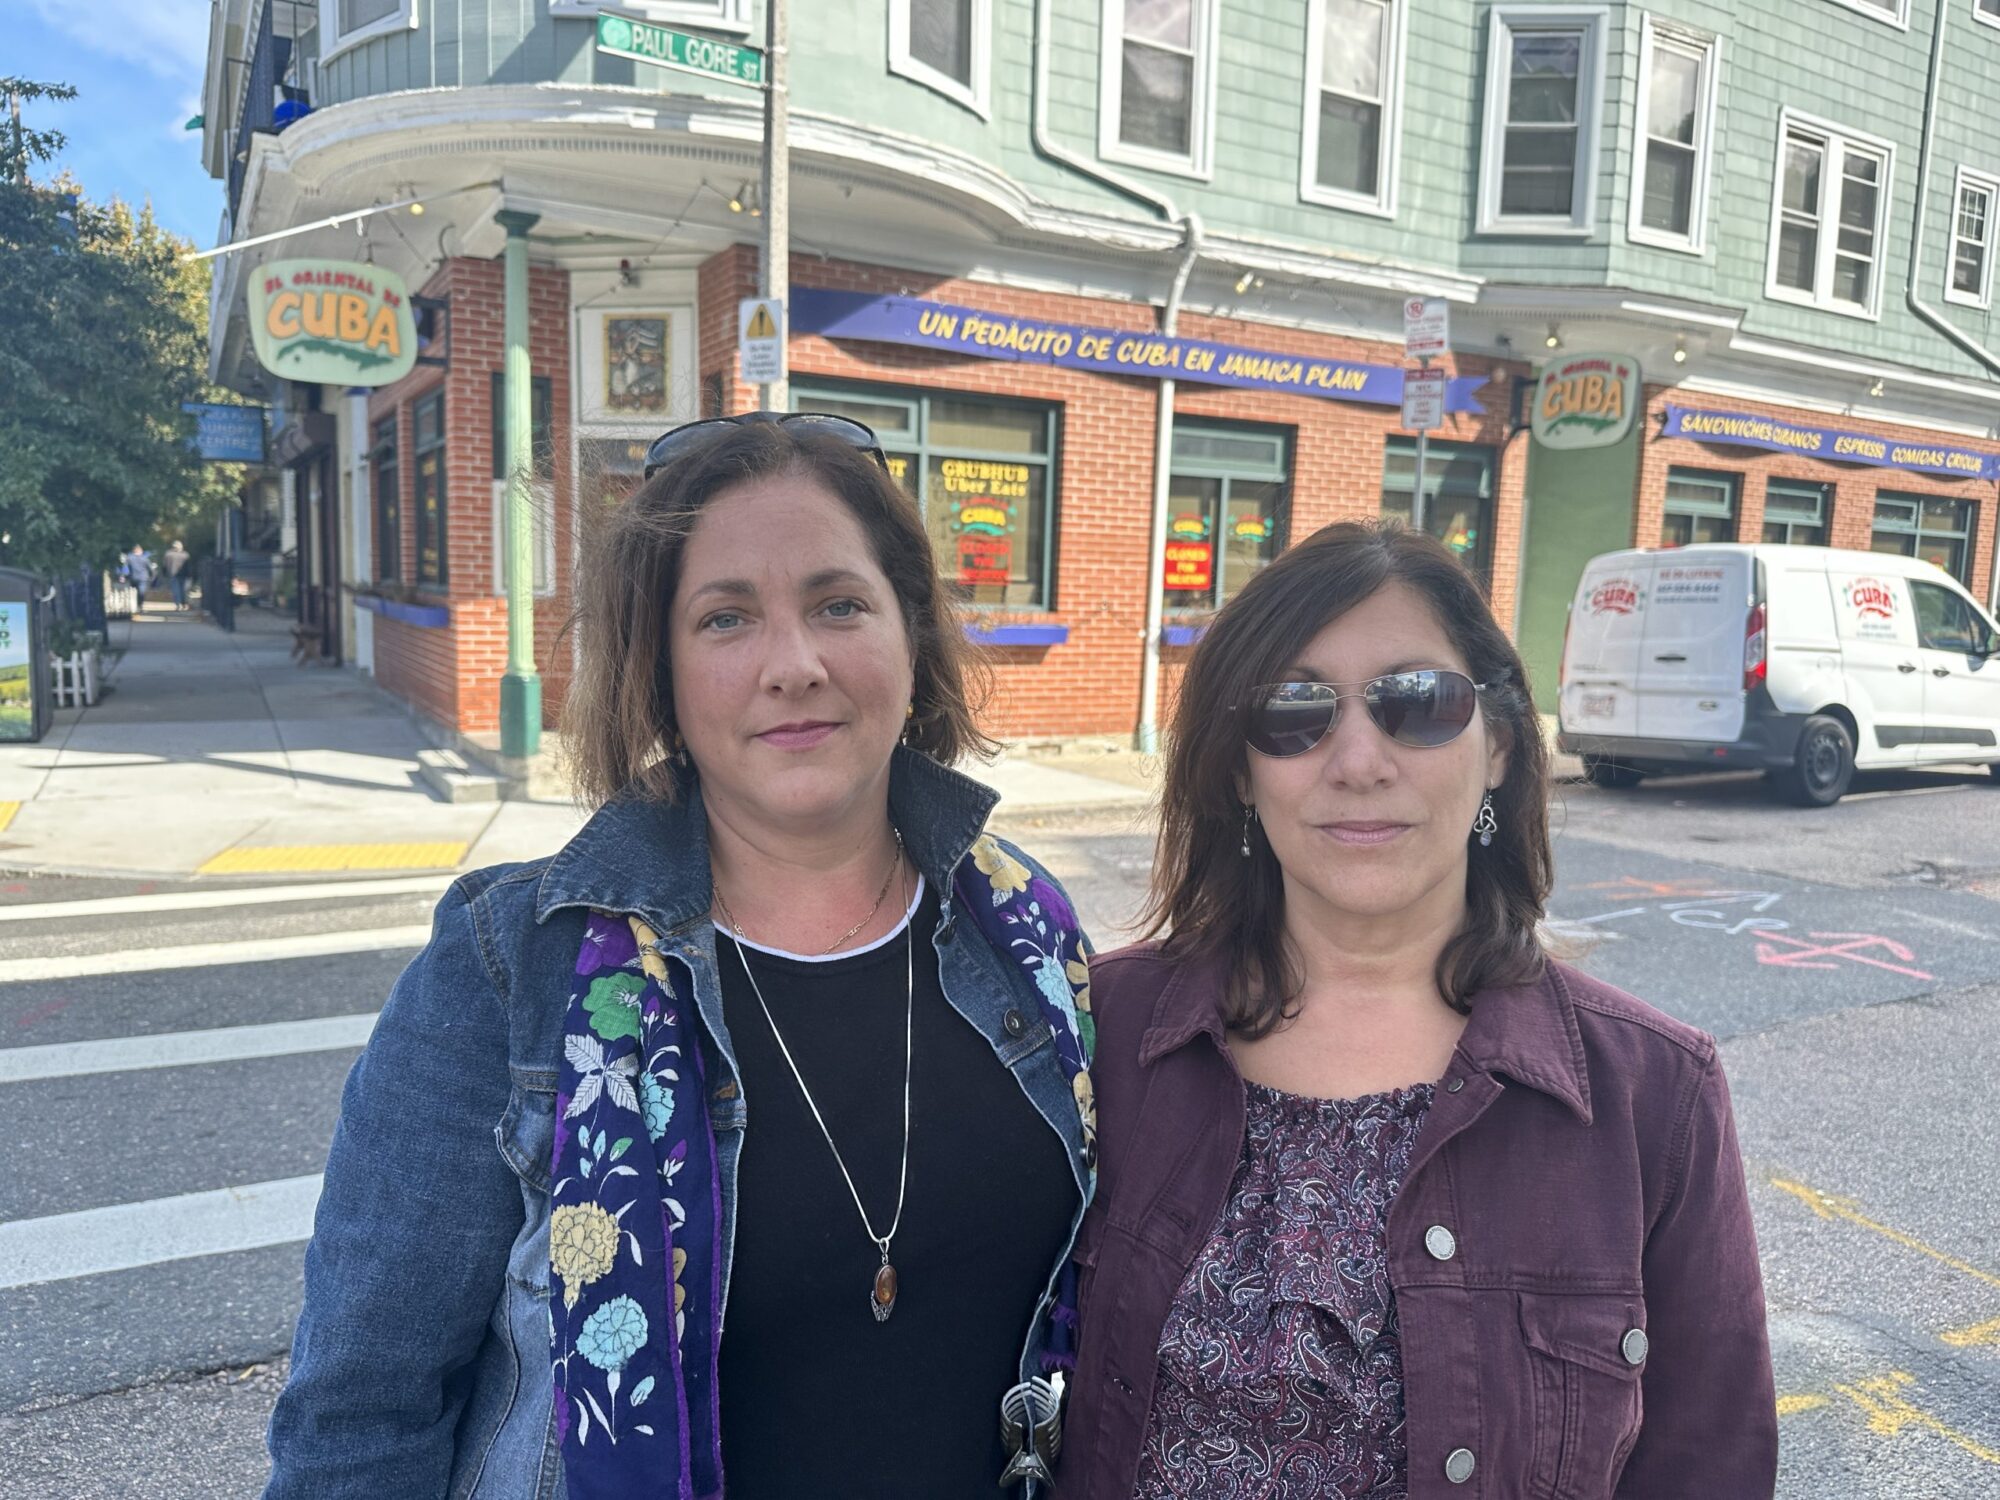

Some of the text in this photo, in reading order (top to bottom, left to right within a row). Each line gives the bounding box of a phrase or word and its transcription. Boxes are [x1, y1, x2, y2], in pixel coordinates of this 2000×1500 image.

[631, 24, 679, 61] PAUL
[684, 38, 739, 76] GORE
[264, 271, 401, 307] EL ORIENTAL DE
[266, 290, 401, 357] CUBA
[918, 308, 1368, 392] UN PEDACITO DE CUBA EN JAMAICA PLAIN
[1543, 375, 1624, 419] CUBA
[1680, 413, 1773, 441] SANDWICHES
[1772, 426, 1823, 450] CUBANOS
[1891, 447, 1945, 466] COMIDAS
[941, 459, 1029, 482] GRUBHUB
[944, 477, 1027, 497] Uber Eats
[1592, 588, 1637, 607] CUBA
[1853, 587, 1892, 608] CUBA
